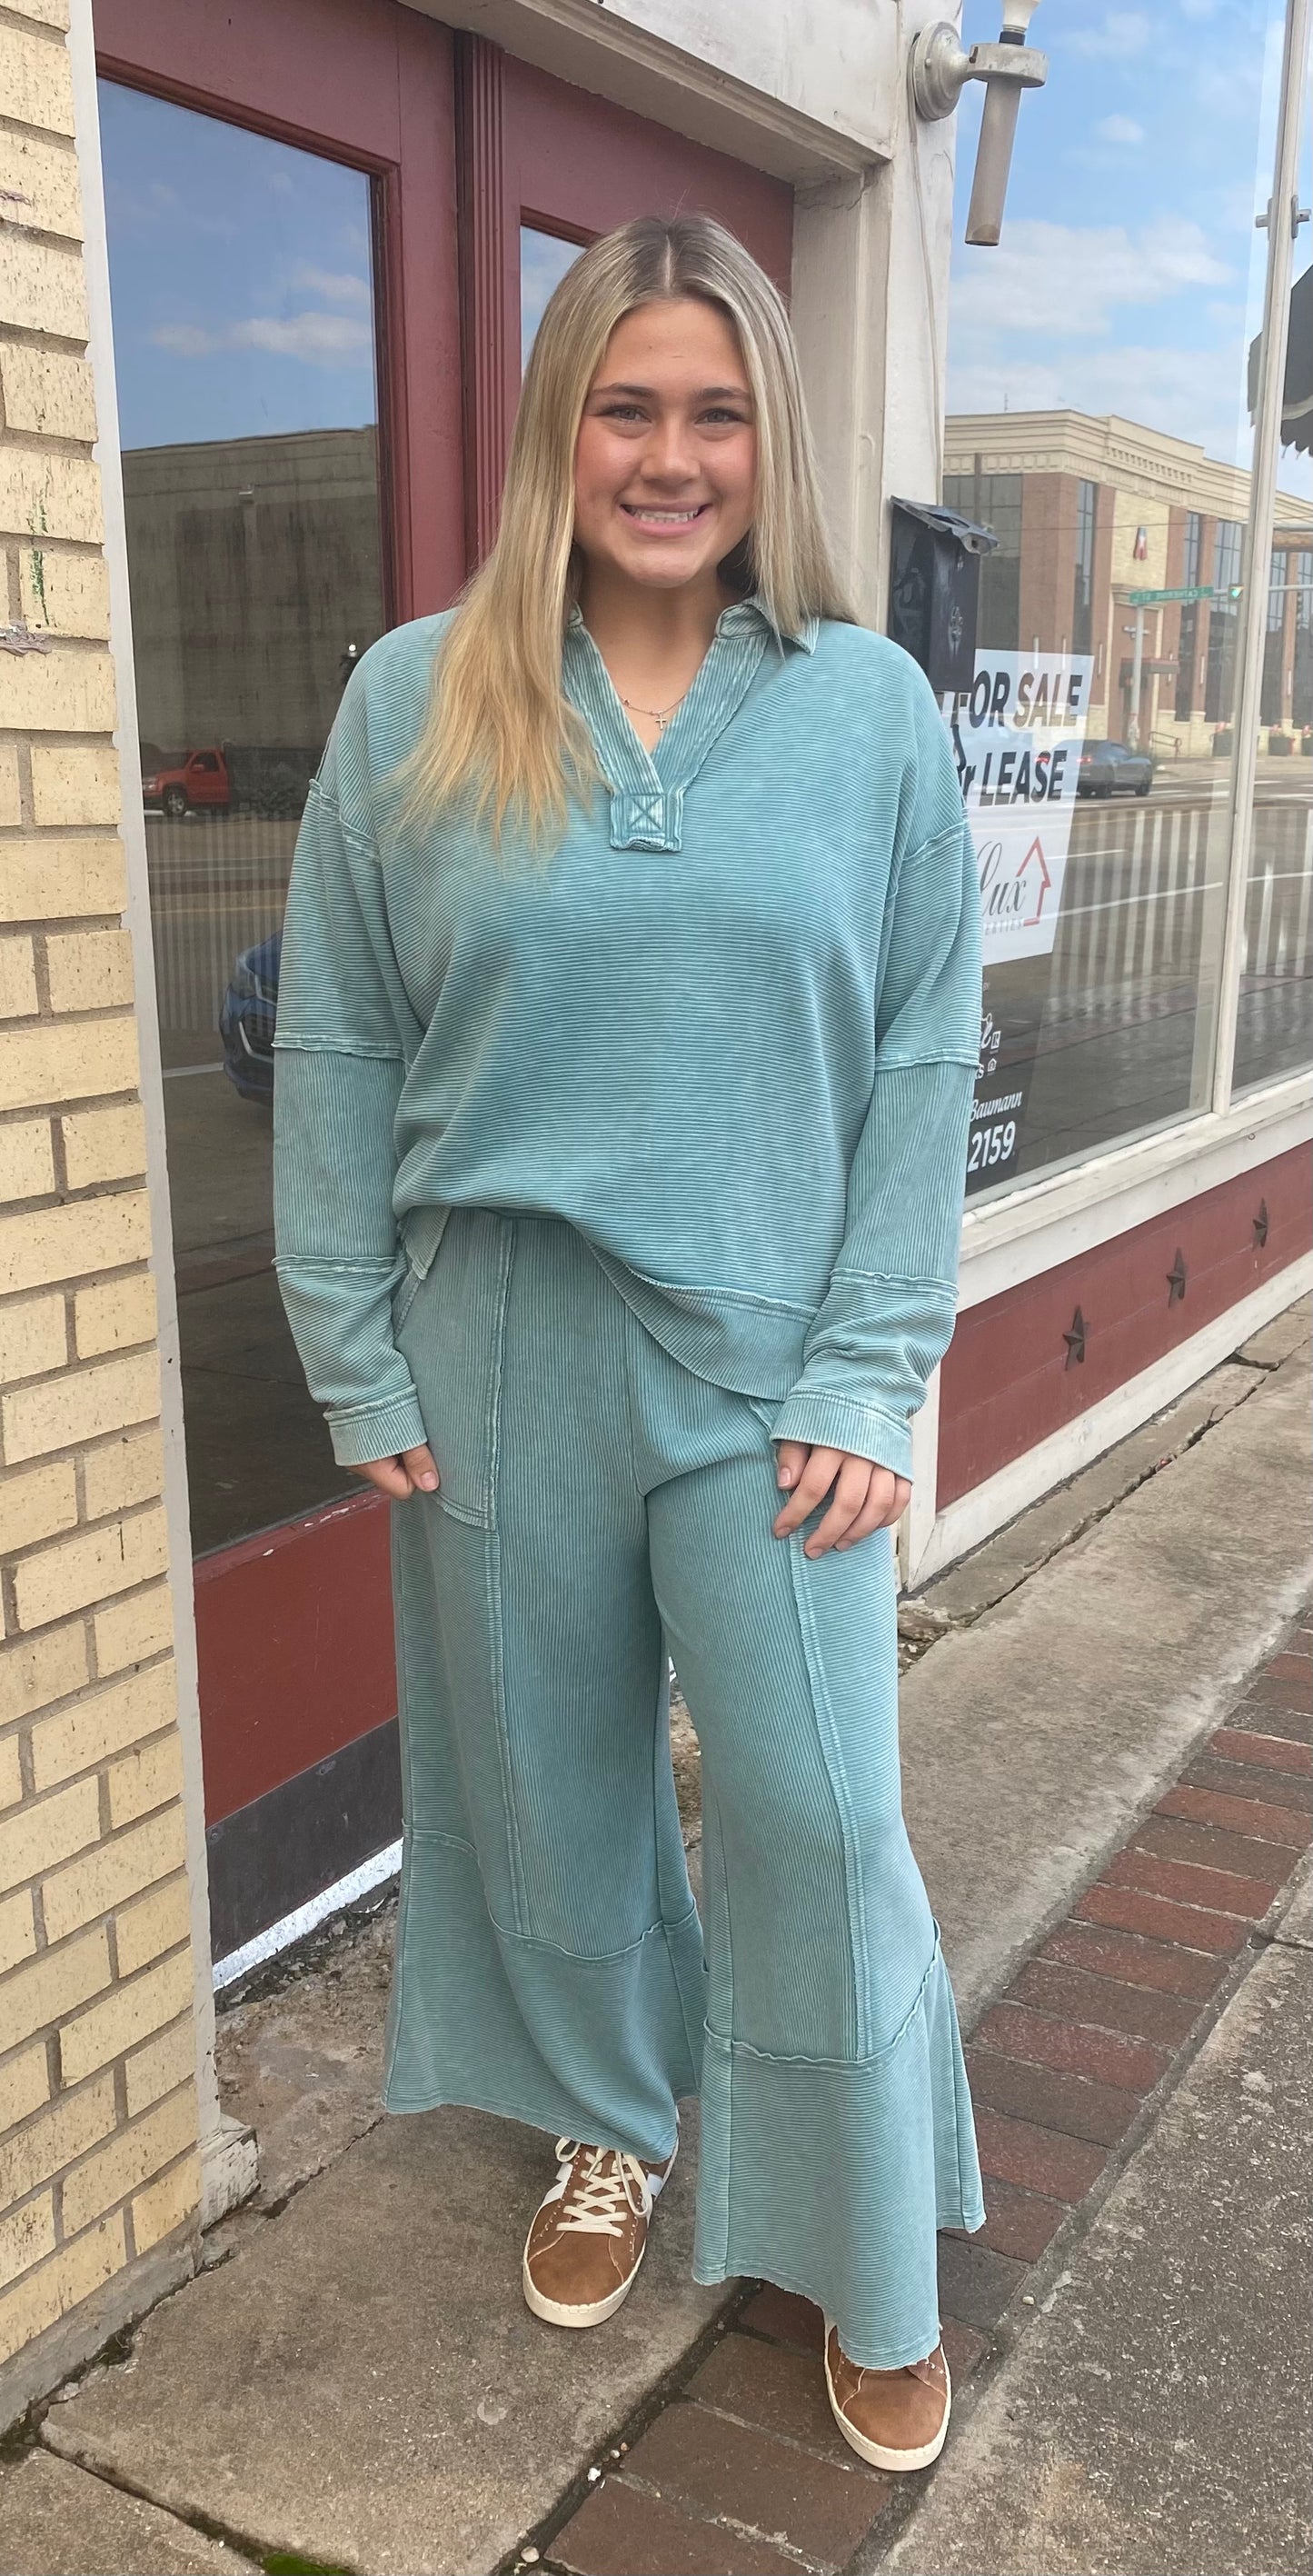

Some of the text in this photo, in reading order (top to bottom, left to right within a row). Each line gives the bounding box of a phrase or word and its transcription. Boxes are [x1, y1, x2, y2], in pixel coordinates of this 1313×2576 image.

[1013, 672, 1083, 727] SALE
[979, 750, 1068, 806] LEASE
[969, 1091, 1022, 1123] Baumann
[967, 1120, 1016, 1173] 2159
